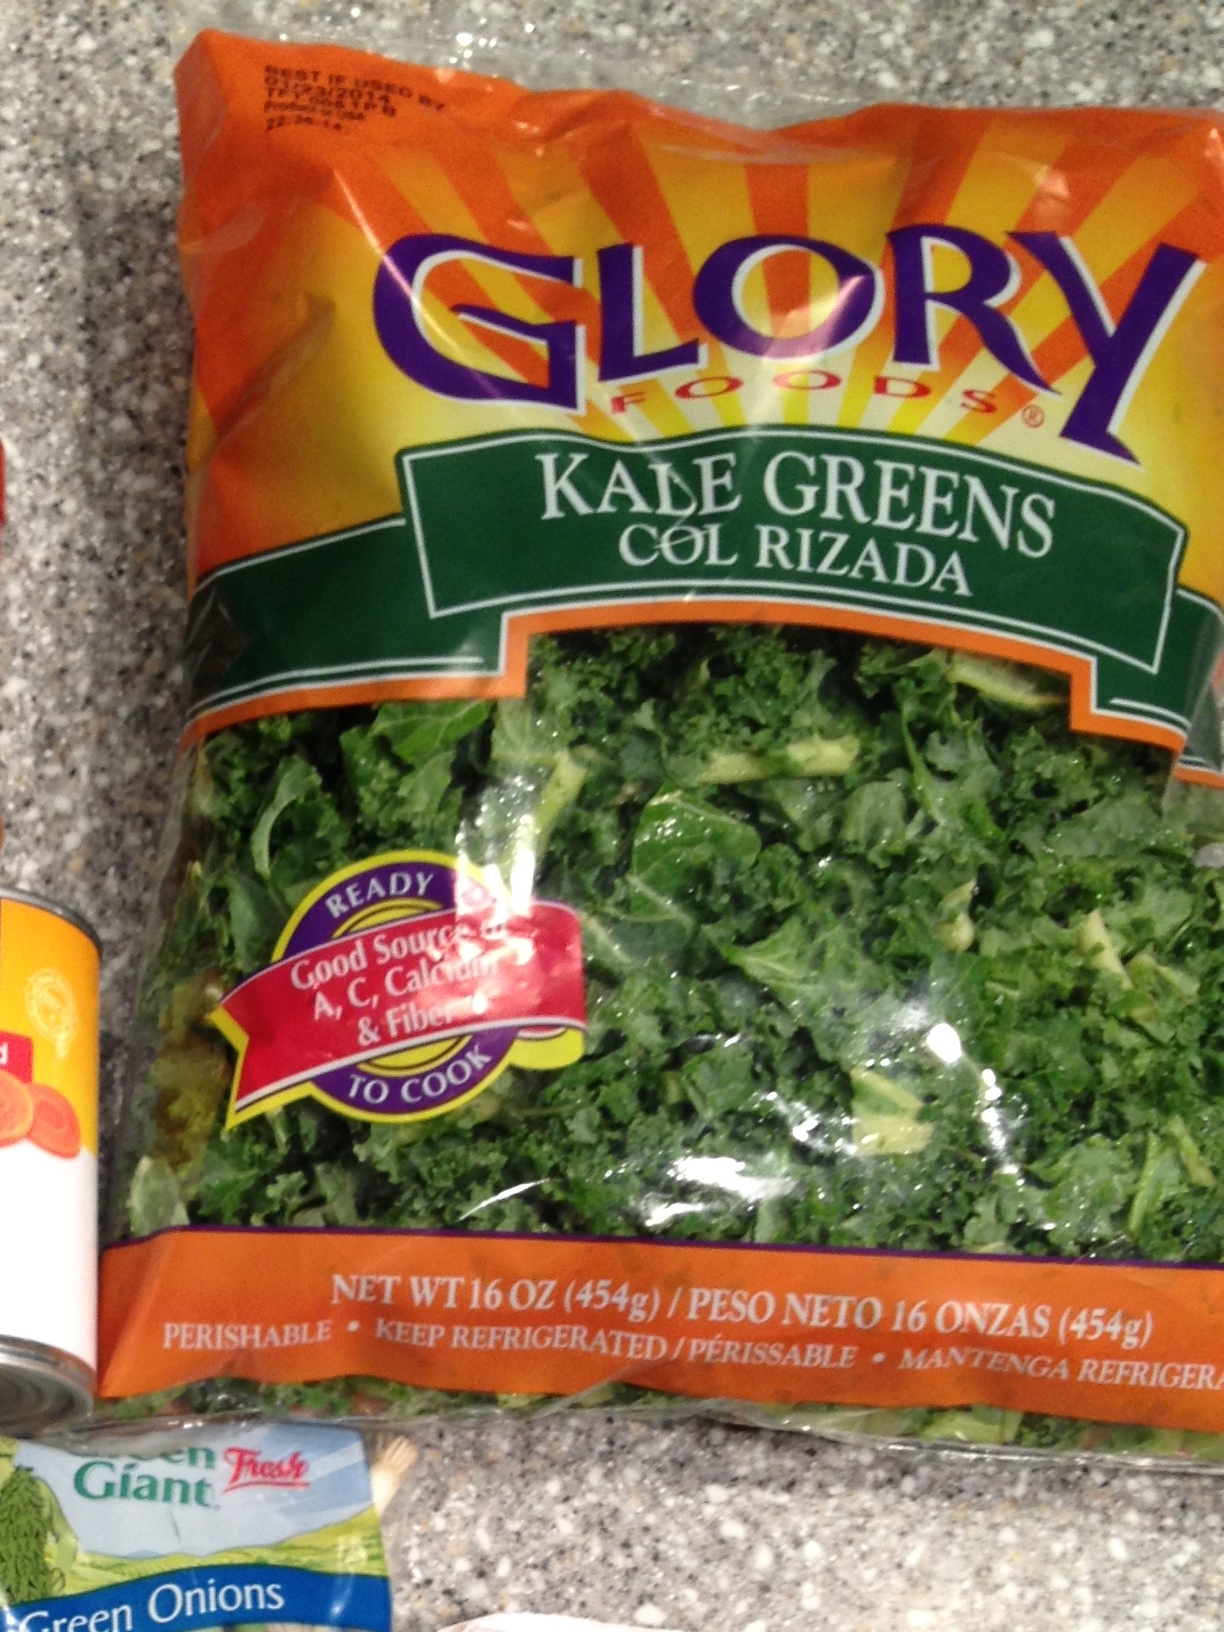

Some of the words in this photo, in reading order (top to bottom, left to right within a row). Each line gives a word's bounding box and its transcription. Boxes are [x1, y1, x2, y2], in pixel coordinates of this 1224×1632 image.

[374, 223, 1204, 472] GLORY
[611, 369, 998, 416] FOODS
[536, 451, 741, 522] KALE
[764, 451, 1059, 559] GREENS
[618, 523, 738, 571] COL
[754, 525, 974, 597] RIZADA
[324, 872, 434, 920] READY
[290, 940, 369, 992] Good
[373, 923, 472, 966] Source
[313, 991, 344, 1021] A,
[347, 980, 380, 1010] C,
[383, 957, 502, 1002] Calcium
[357, 1019, 382, 1048] &
[385, 1004, 456, 1045] Fiber
[347, 1074, 389, 1105] TO
[400, 1045, 493, 1105] COOK
[331, 1274, 400, 1306] NET
[408, 1275, 464, 1308] WT
[471, 1278, 501, 1310] 16
[509, 1280, 557, 1312] OZ
[563, 1281, 661, 1323] (454g)
[687, 1287, 775, 1325] PESO
[781, 1292, 881, 1331] NETO
[891, 1299, 925, 1332] 16
[933, 1300, 1050, 1339] ONZAS
[1058, 1306, 1154, 1350] (454g)
[163, 1319, 333, 1350] PERISHABLE
[375, 1318, 445, 1349] KEEP
[450, 1324, 669, 1361] REFRIGERATED
[898, 1347, 1069, 1382] MANTENGA
[73, 1460, 212, 1508] Giant
[222, 1446, 308, 1484] Fresh
[148, 1580, 285, 1624] Onions
